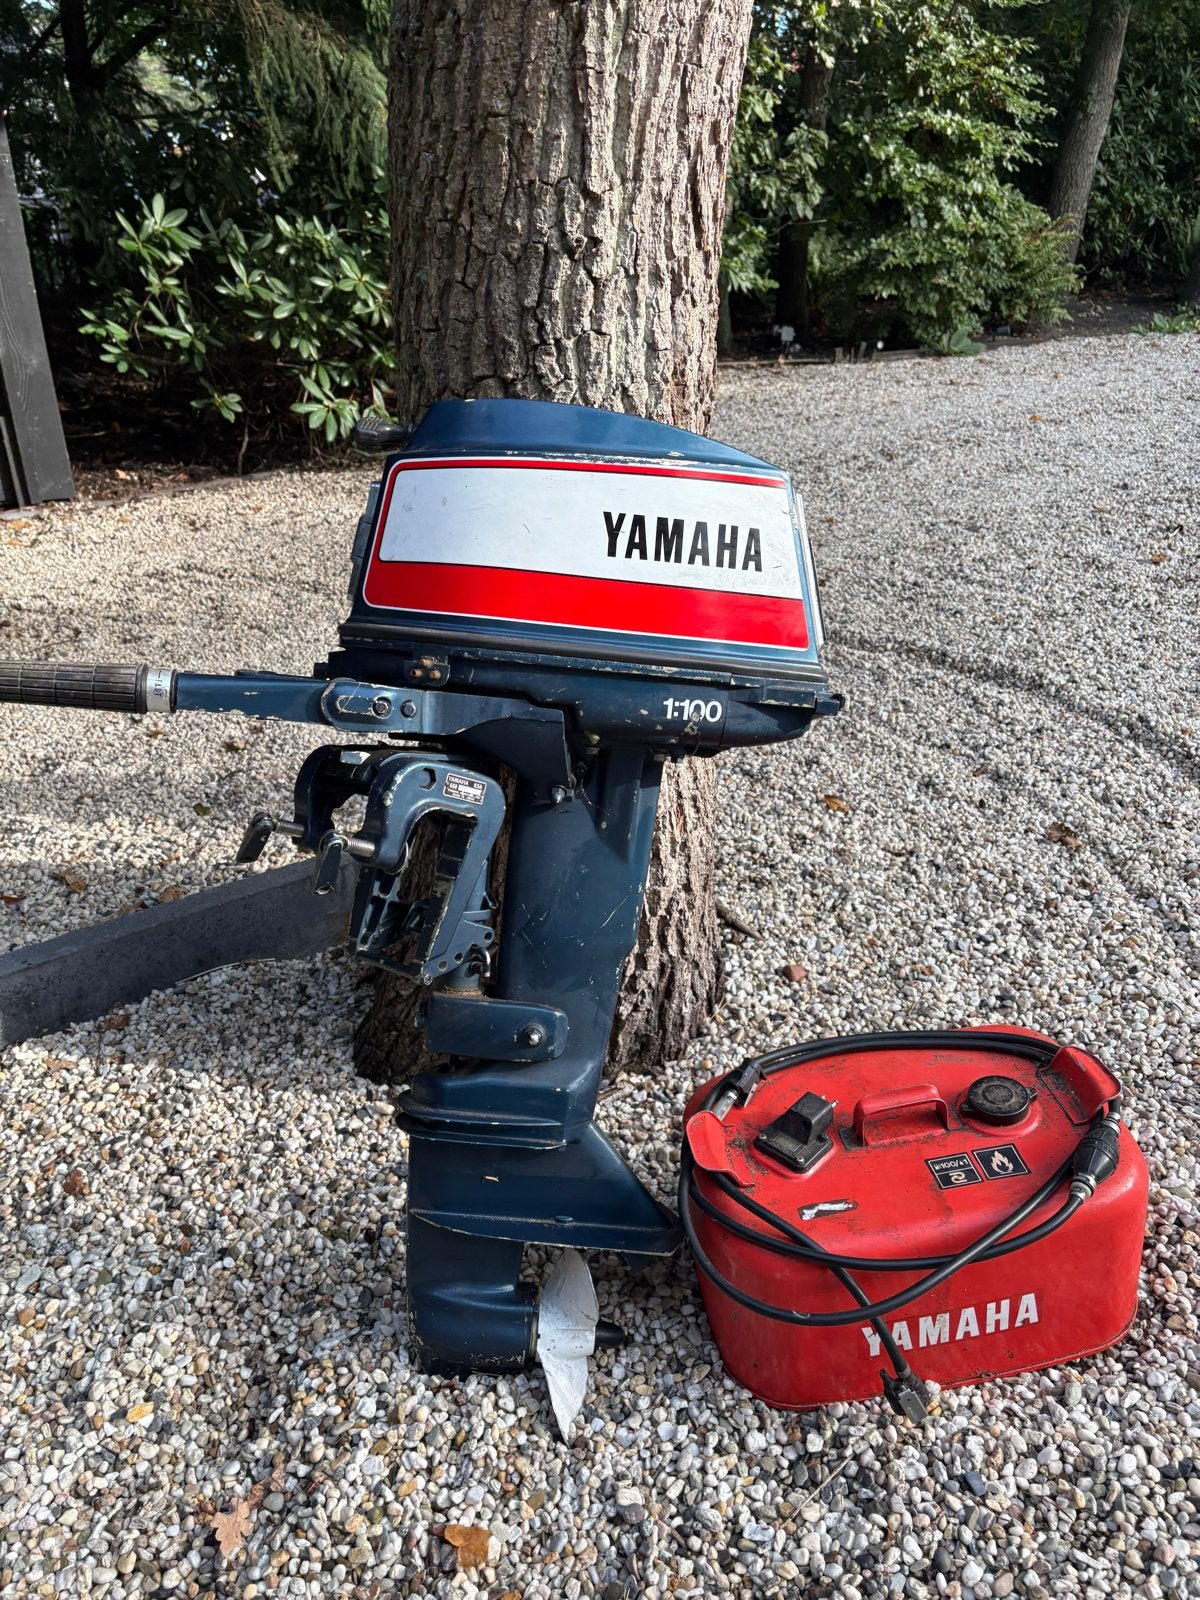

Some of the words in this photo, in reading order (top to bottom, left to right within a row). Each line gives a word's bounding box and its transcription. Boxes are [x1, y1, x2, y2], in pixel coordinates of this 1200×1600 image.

[603, 511, 762, 572] YAMAHA
[663, 698, 722, 722] 1:100
[448, 776, 468, 786] YAMAHA
[861, 1293, 1039, 1357] YAMAHA
